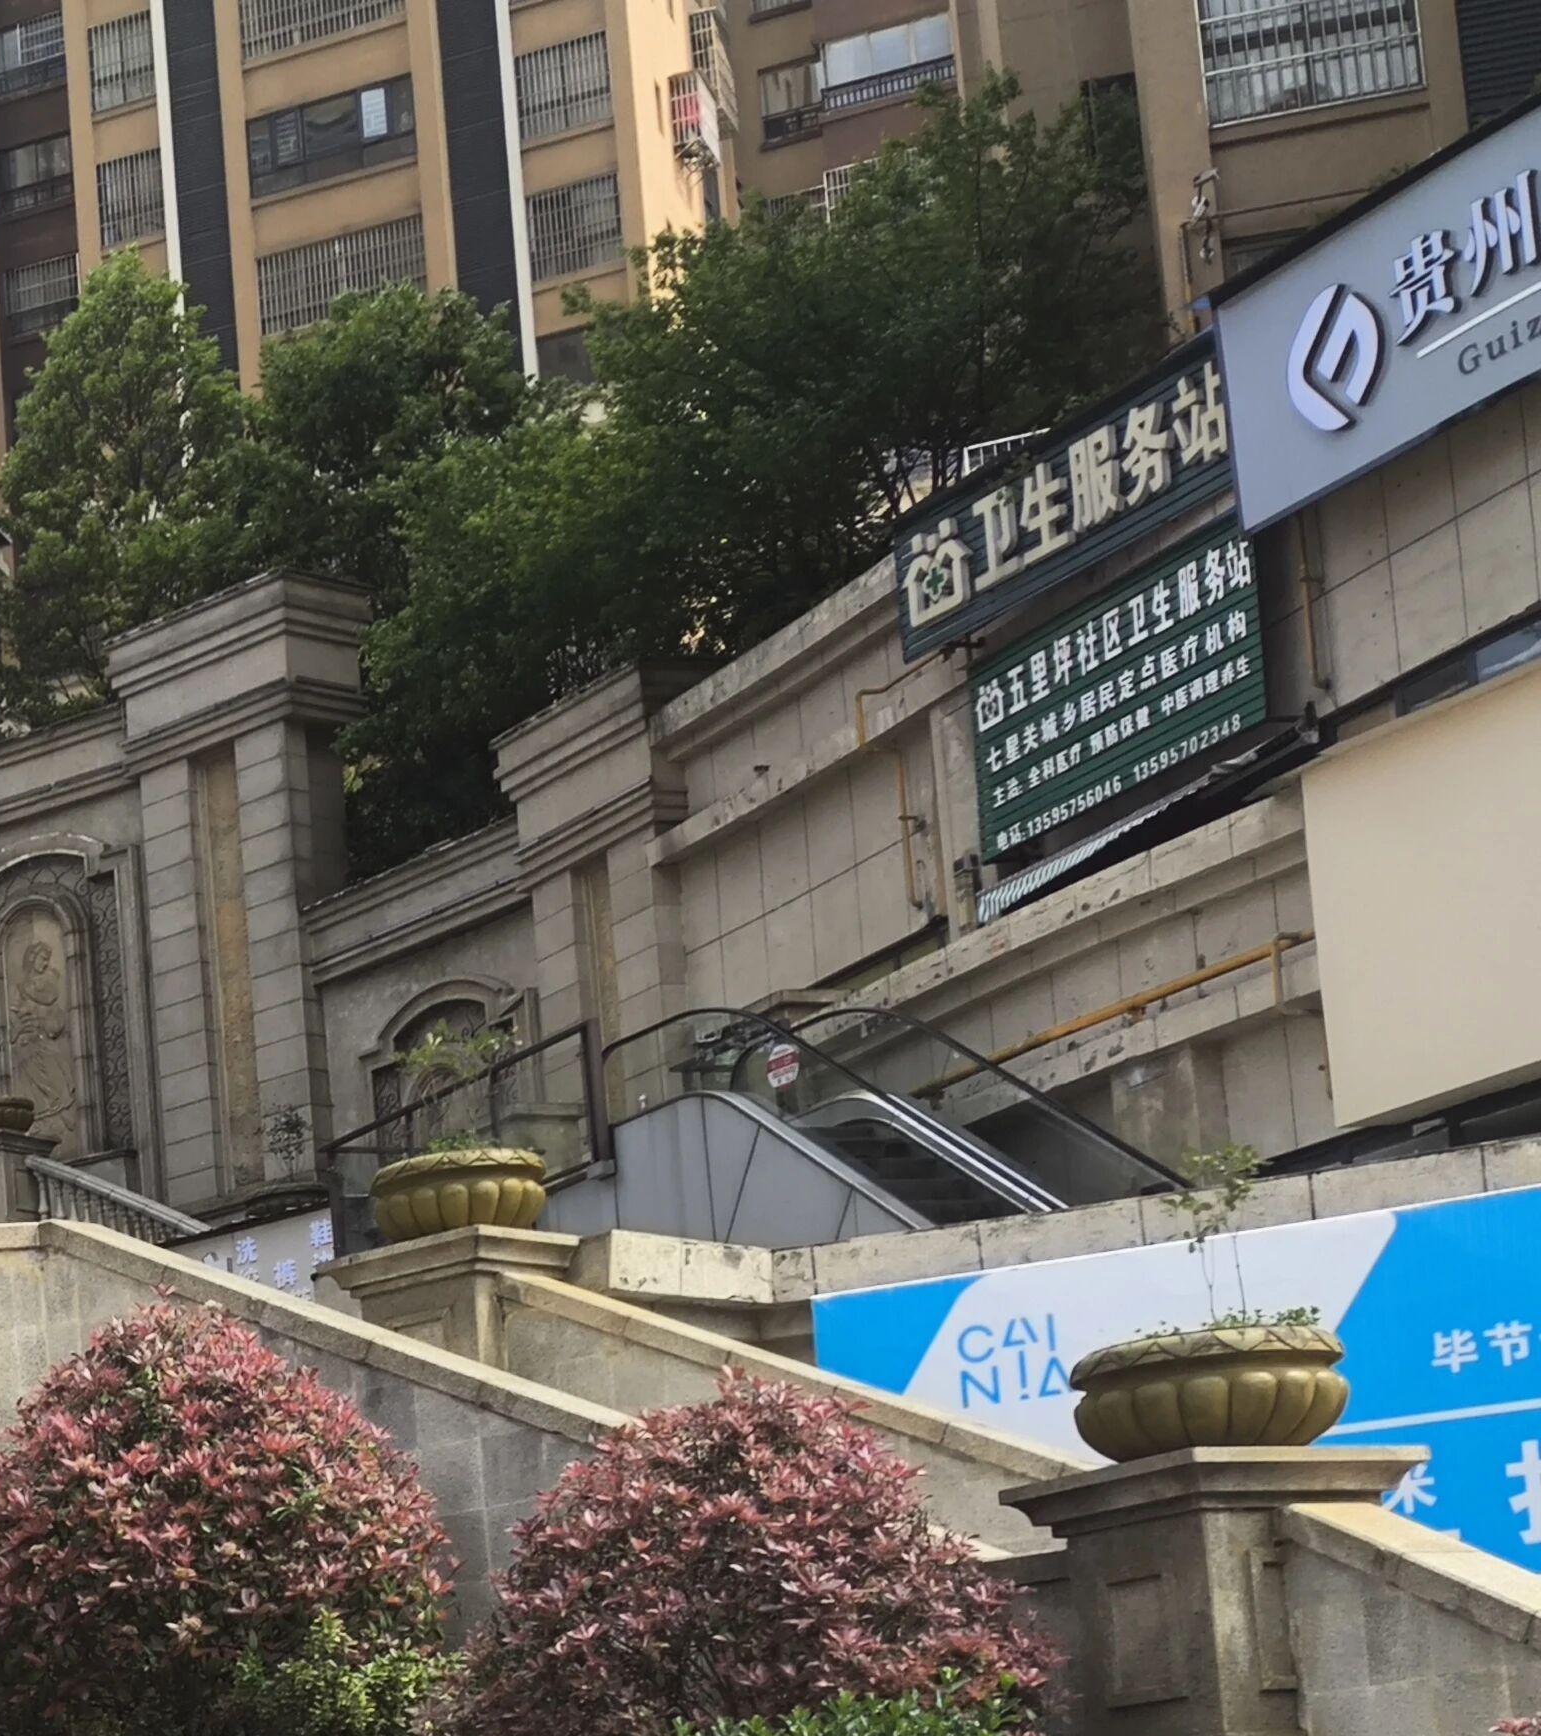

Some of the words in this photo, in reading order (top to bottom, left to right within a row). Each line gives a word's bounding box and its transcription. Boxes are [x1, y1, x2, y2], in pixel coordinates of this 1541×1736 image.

[1389, 169, 1539, 347] 贵州
[973, 361, 1229, 592] 卫生服务站
[985, 610, 1247, 773] 七星关城乡居民定点医疗机构
[1006, 541, 1252, 715] 五里坪社区卫生服务站
[1028, 742, 1082, 789] 全科医疗
[1133, 712, 1242, 783] 13595702348
[1431, 1320, 1541, 1373] 毕节
